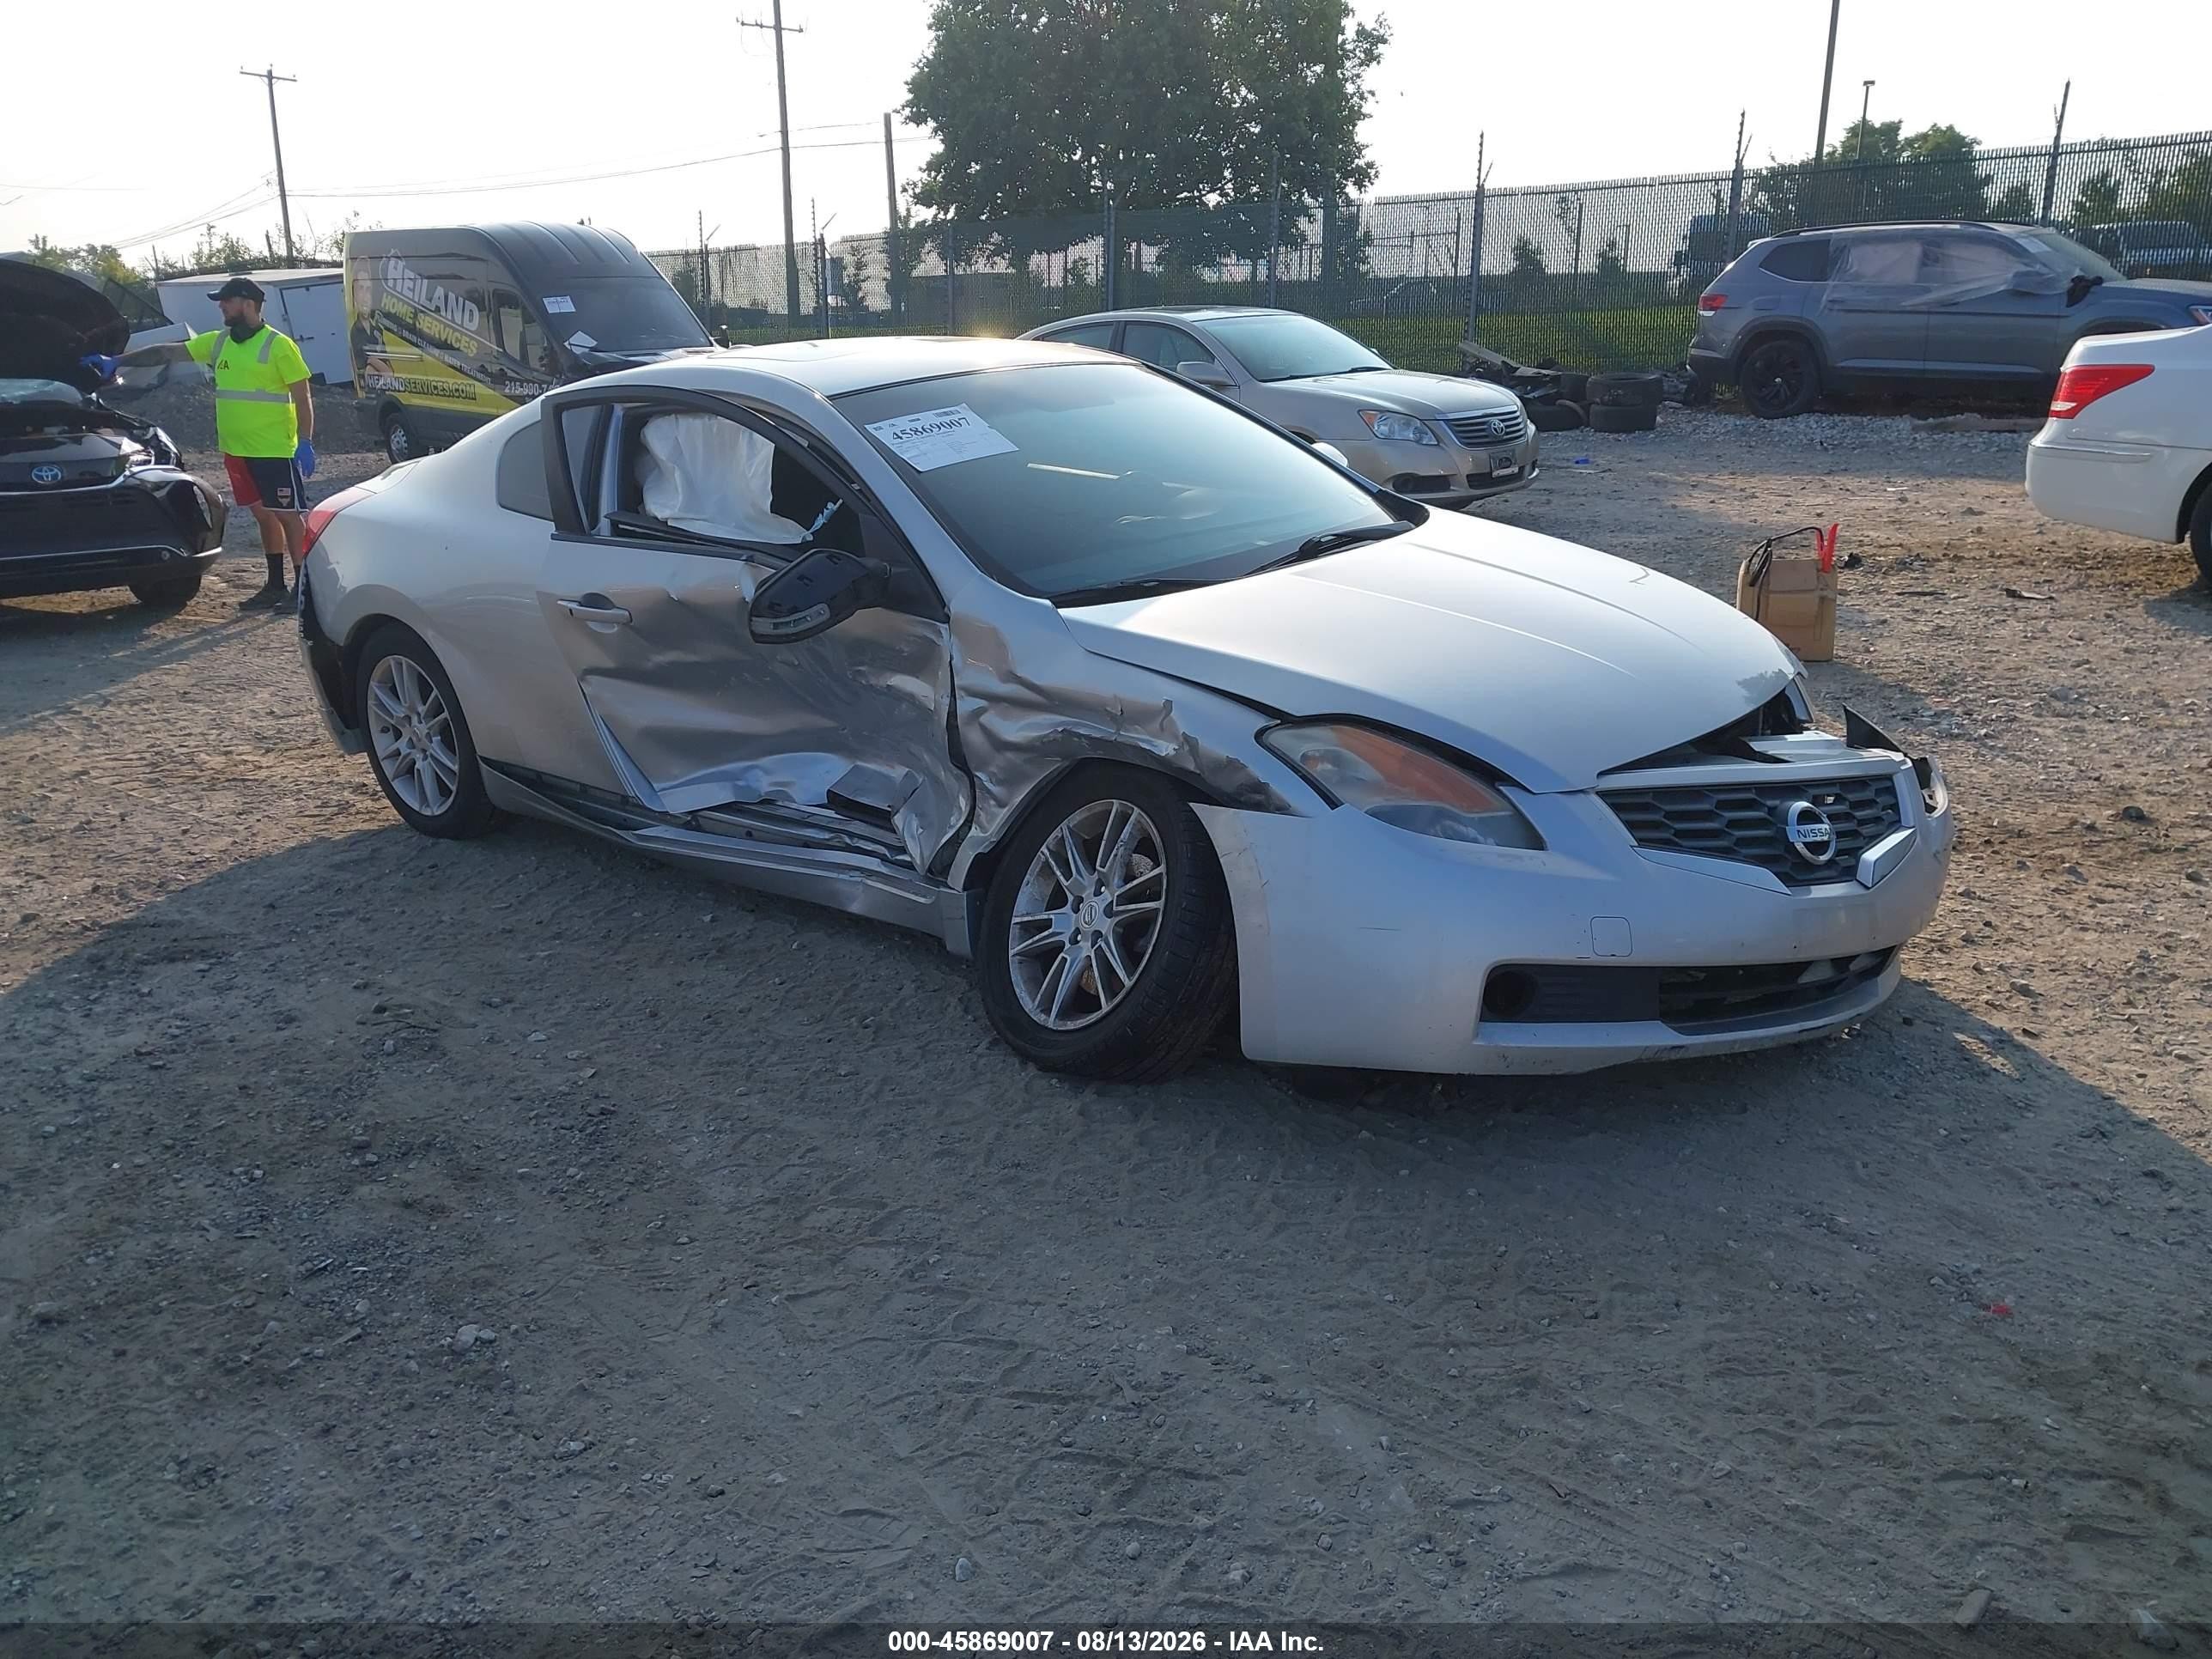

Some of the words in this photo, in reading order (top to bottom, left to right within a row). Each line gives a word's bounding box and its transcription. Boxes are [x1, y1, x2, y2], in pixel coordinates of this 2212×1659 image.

[386, 257, 480, 331] HEILAND
[380, 292, 415, 324] HOME
[416, 311, 478, 357] SERVICES
[504, 380, 558, 396] 215-990-7
[892, 417, 970, 441] 45869007
[1797, 827, 1831, 839] NISSA
